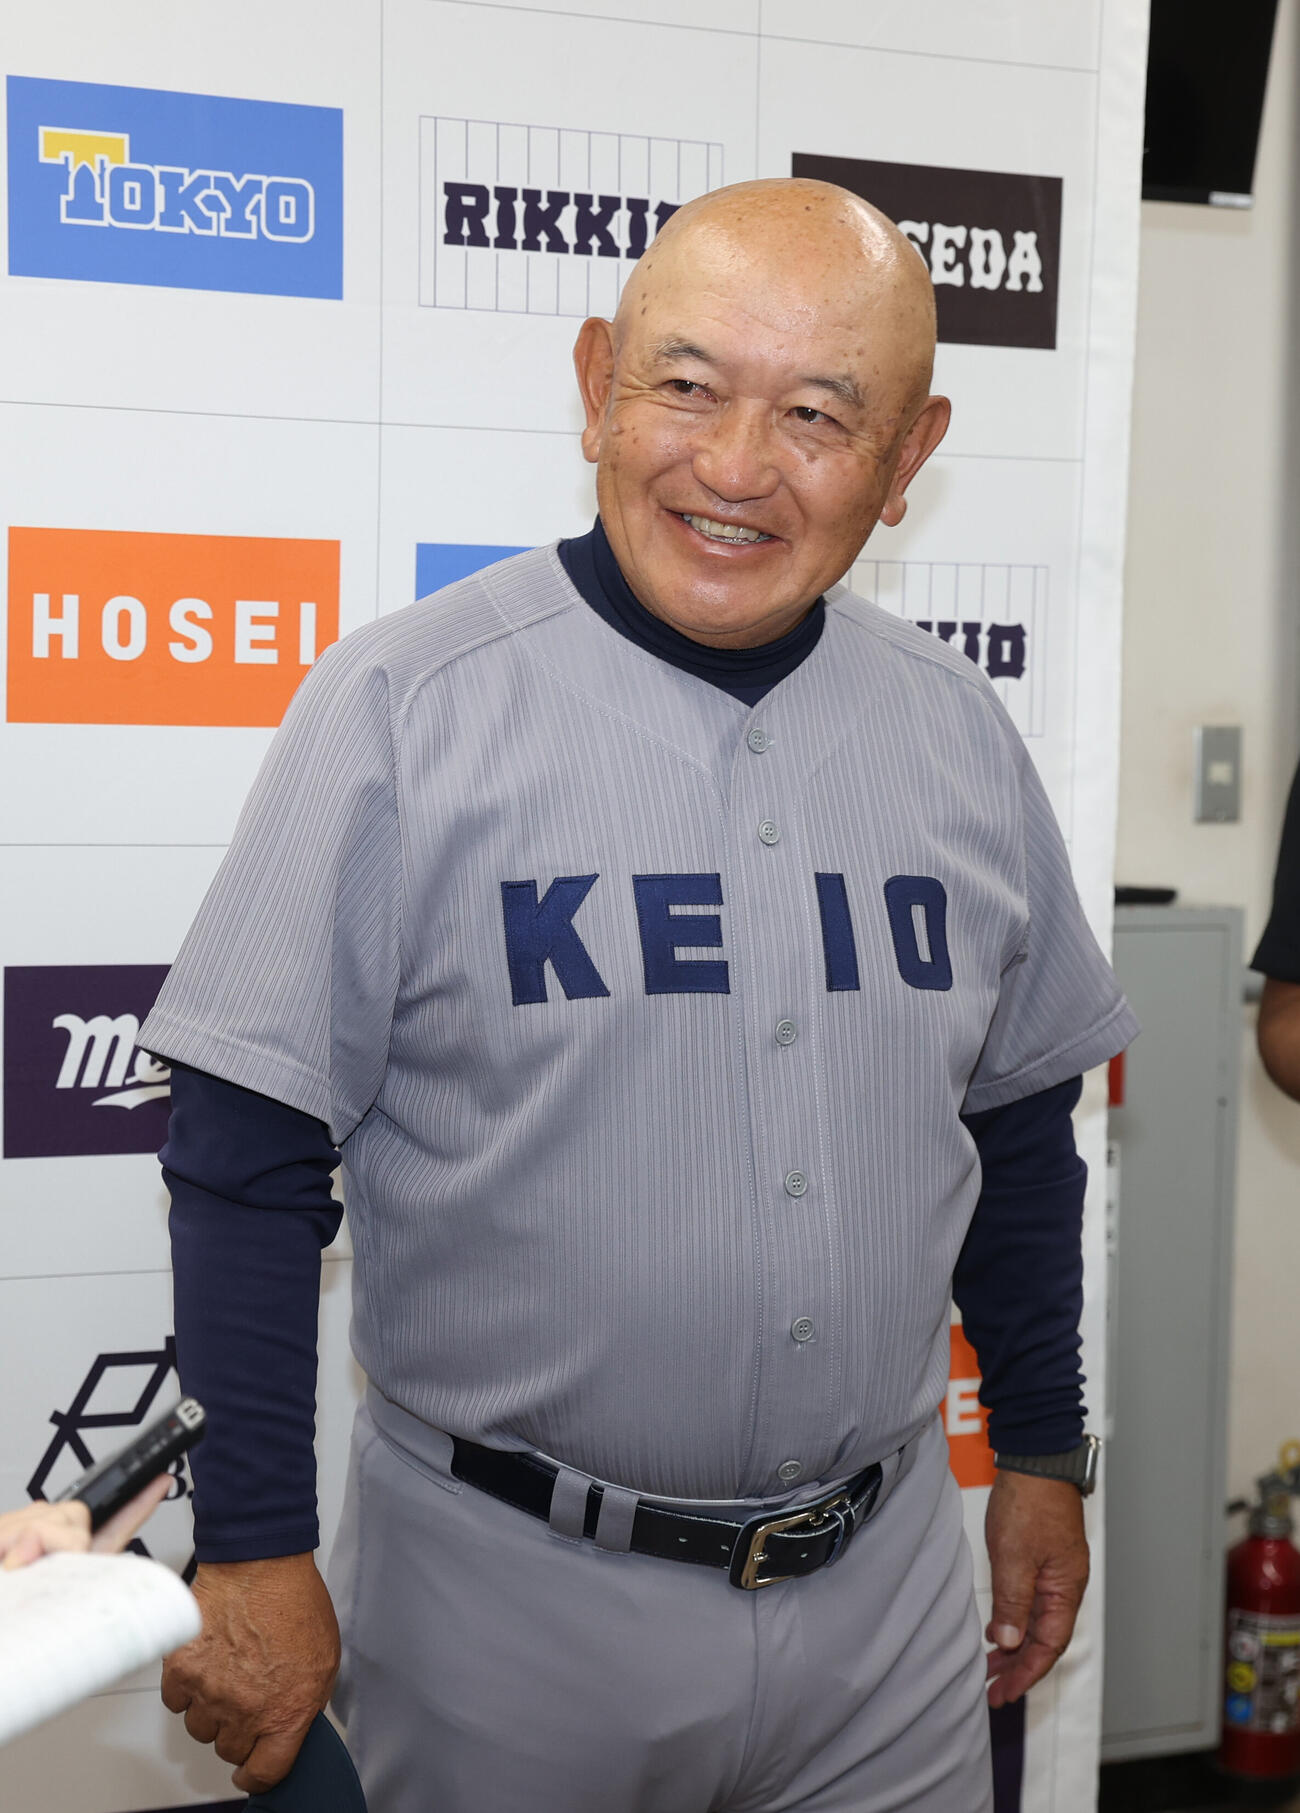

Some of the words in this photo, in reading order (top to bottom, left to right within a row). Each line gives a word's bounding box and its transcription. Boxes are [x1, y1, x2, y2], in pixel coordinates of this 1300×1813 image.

[38, 125, 315, 243] TOKYO
[32, 593, 317, 665] HOSEI
[500, 872, 954, 1007] KEIO
